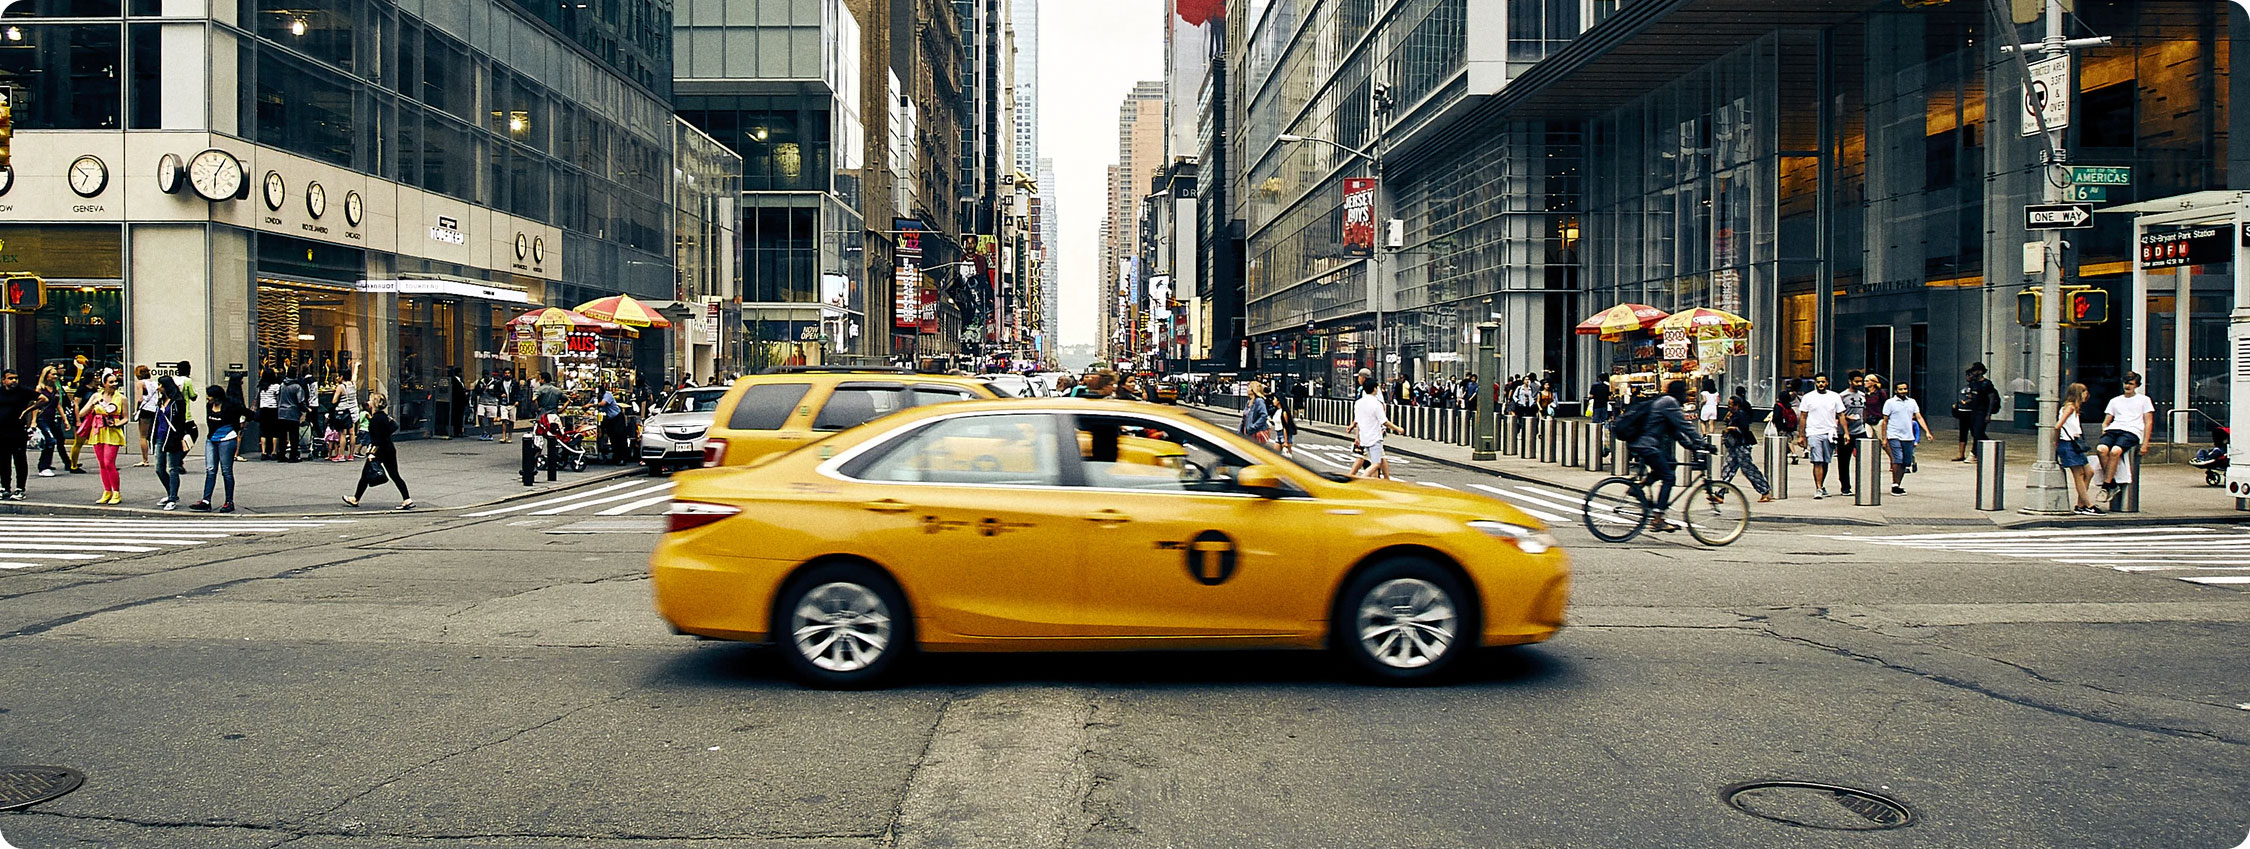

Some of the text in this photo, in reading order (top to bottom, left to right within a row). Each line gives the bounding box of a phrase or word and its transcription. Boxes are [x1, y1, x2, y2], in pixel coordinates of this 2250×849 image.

[2051, 73, 2065, 86] 33FT
[2055, 89, 2060, 98] &
[2050, 101, 2065, 113] OVER
[2075, 173, 2128, 183] AMERICAS
[2077, 187, 2088, 200] 6
[1343, 191, 1374, 210] JERSEY
[72, 205, 105, 213] GENEVA
[1347, 206, 1370, 222] BOYS
[264, 216, 282, 225] LONDON
[2034, 211, 2083, 222] ONE WAY
[345, 231, 361, 240] CHICAGO
[902, 228, 920, 238] 140
[2149, 233, 2177, 244] St-Bryant
[2177, 232, 2191, 240] Park
[2193, 229, 2216, 239] Station
[2143, 244, 2186, 258] B D F M
[1032, 258, 1041, 330] TUSSAUDS
[803, 326, 819, 334] NOW
[801, 332, 819, 340] OPEN
[567, 336, 597, 351] AUS
